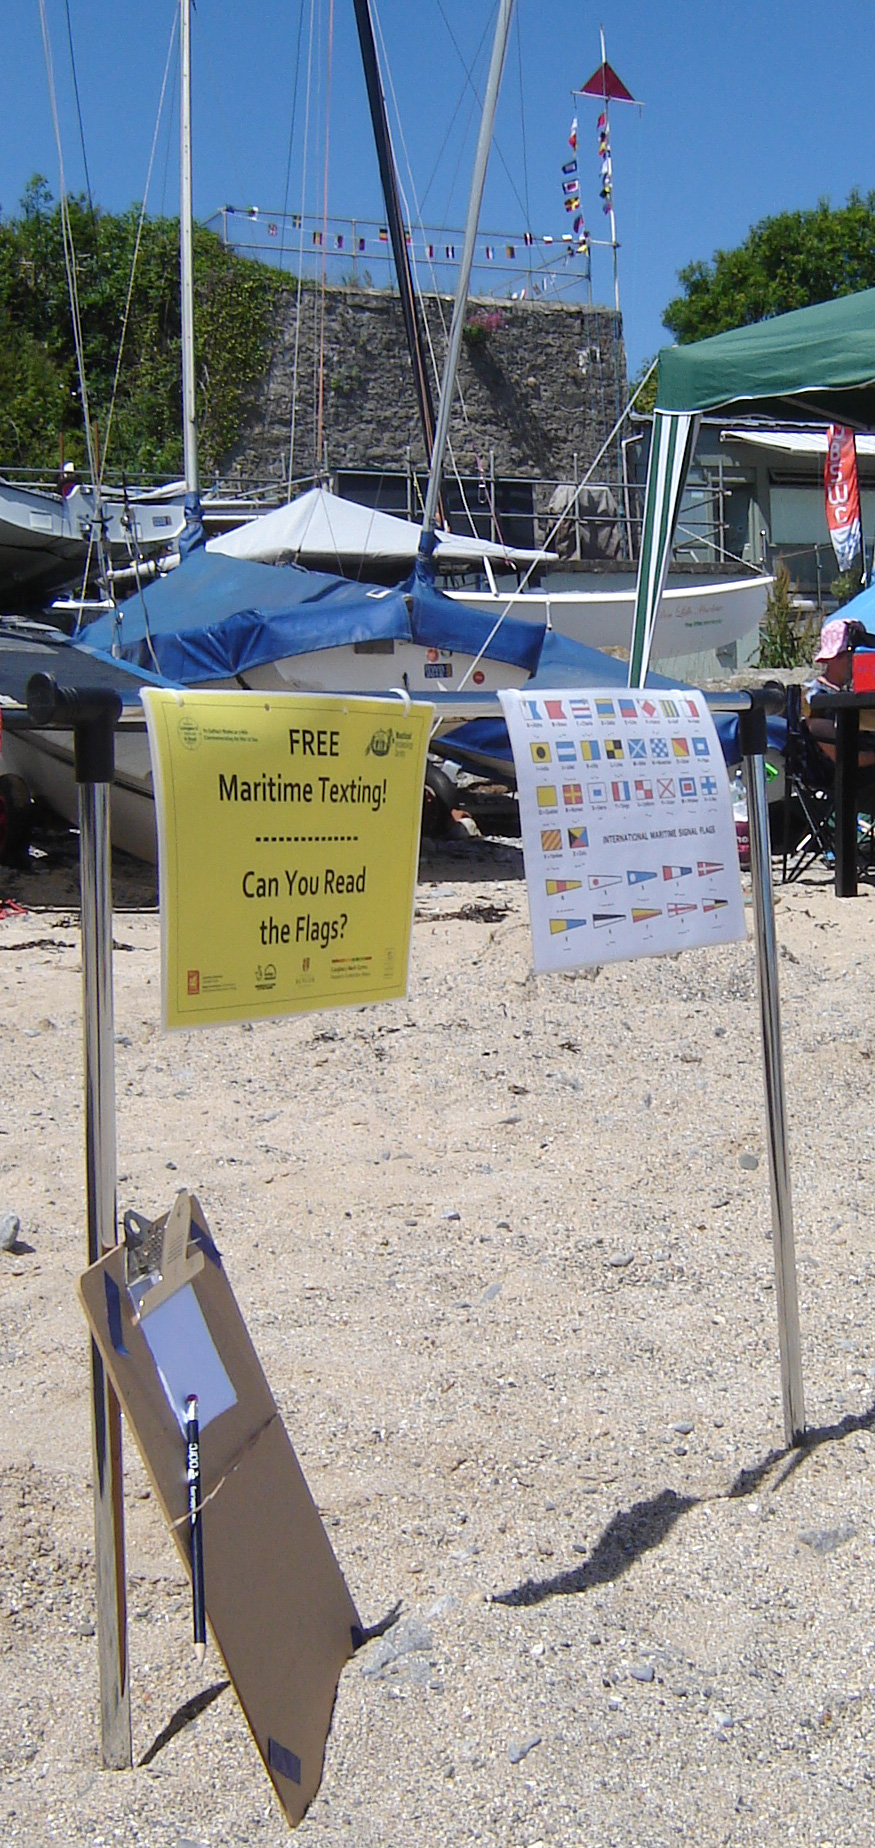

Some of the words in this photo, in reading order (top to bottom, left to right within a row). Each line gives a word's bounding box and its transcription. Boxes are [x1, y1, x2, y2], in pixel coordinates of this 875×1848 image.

[289, 729, 339, 756] FREE
[219, 773, 312, 802] Maritime
[318, 776, 386, 811] Texting!
[602, 832, 649, 844] INTERNATIONAL
[649, 828, 678, 840] MARITIME
[678, 827, 699, 837] SIGNAL
[699, 825, 717, 835] FLAGS
[243, 871, 278, 898] Can
[285, 870, 319, 896] You
[324, 866, 366, 894] Read
[260, 916, 290, 945] the
[296, 914, 347, 949] Flags?
